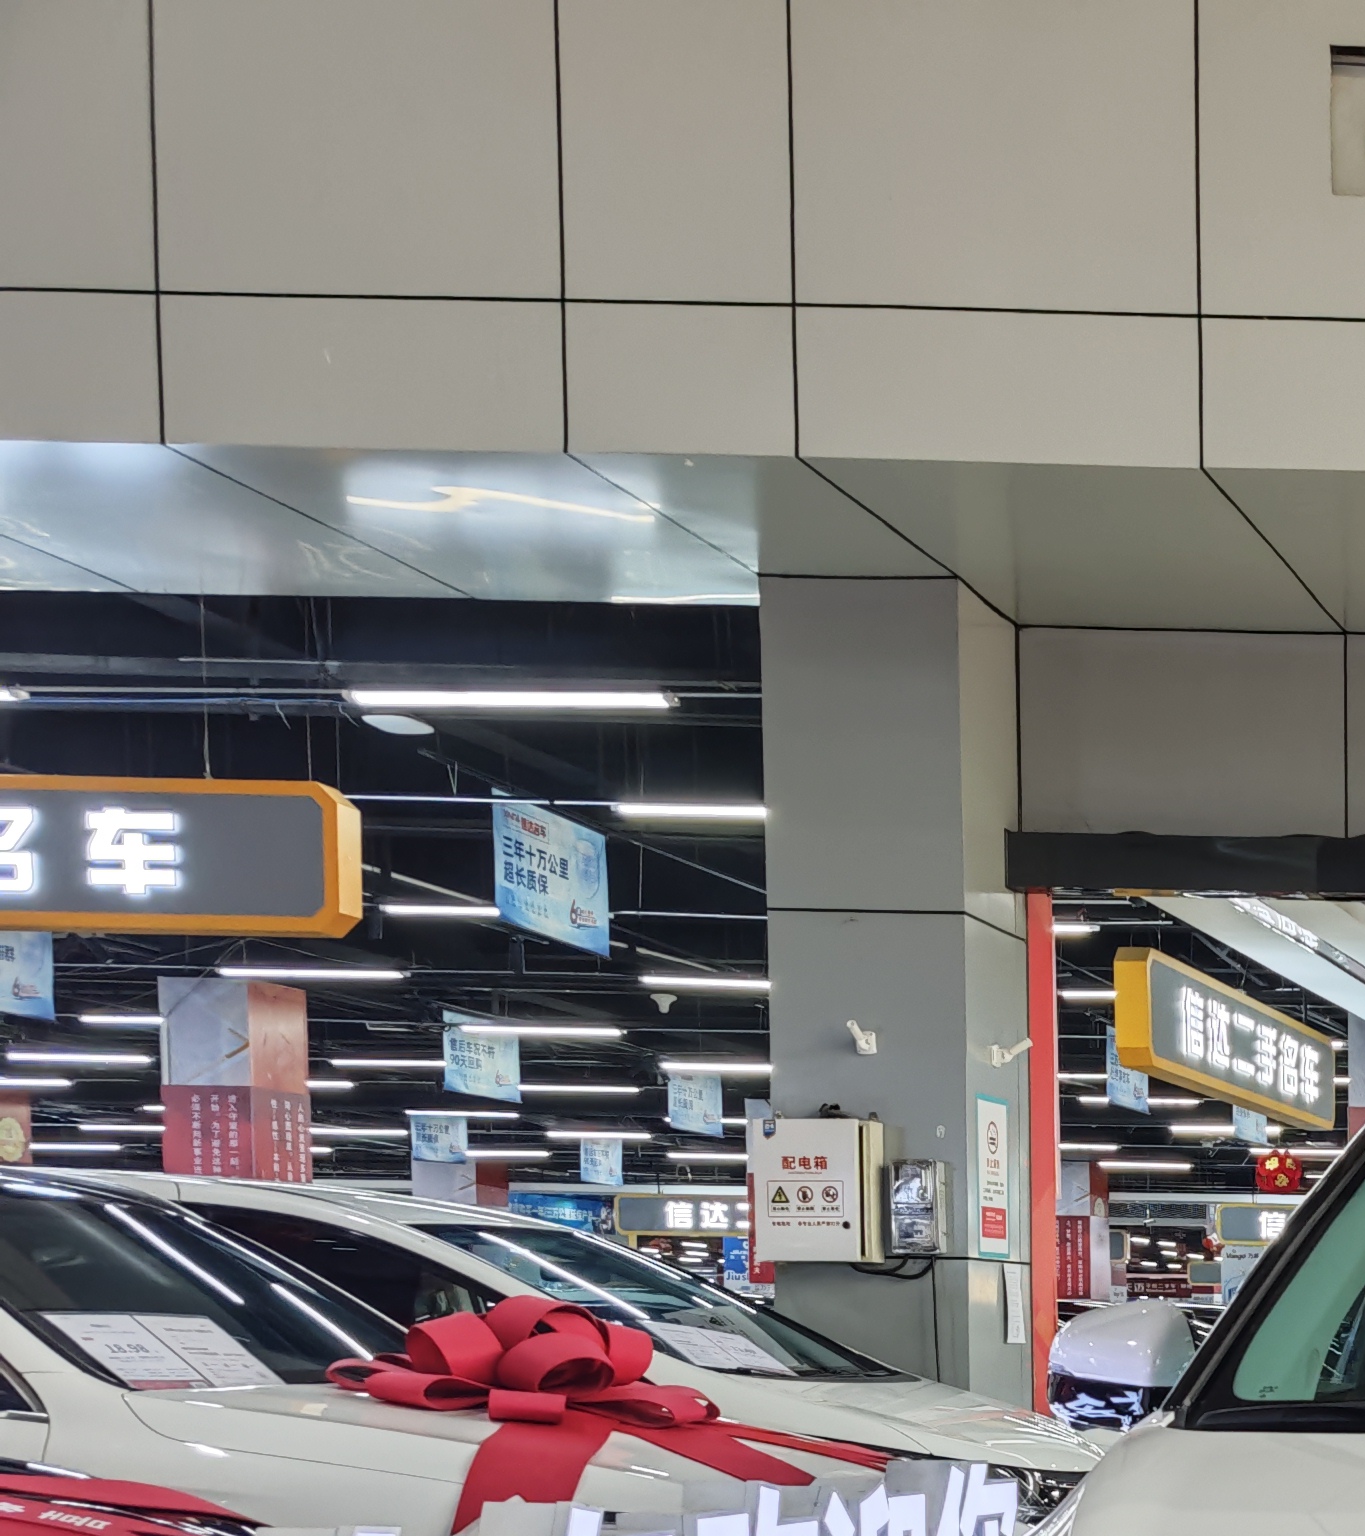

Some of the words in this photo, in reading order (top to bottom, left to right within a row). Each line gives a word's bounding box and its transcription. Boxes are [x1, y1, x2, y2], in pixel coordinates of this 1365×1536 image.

[503, 835, 569, 880] 三年十万公里
[503, 861, 549, 897] 超长质保
[1180, 984, 1320, 1104] 信达二手名车
[781, 1155, 828, 1170] 配电箱
[105, 1343, 151, 1355] 18.98
